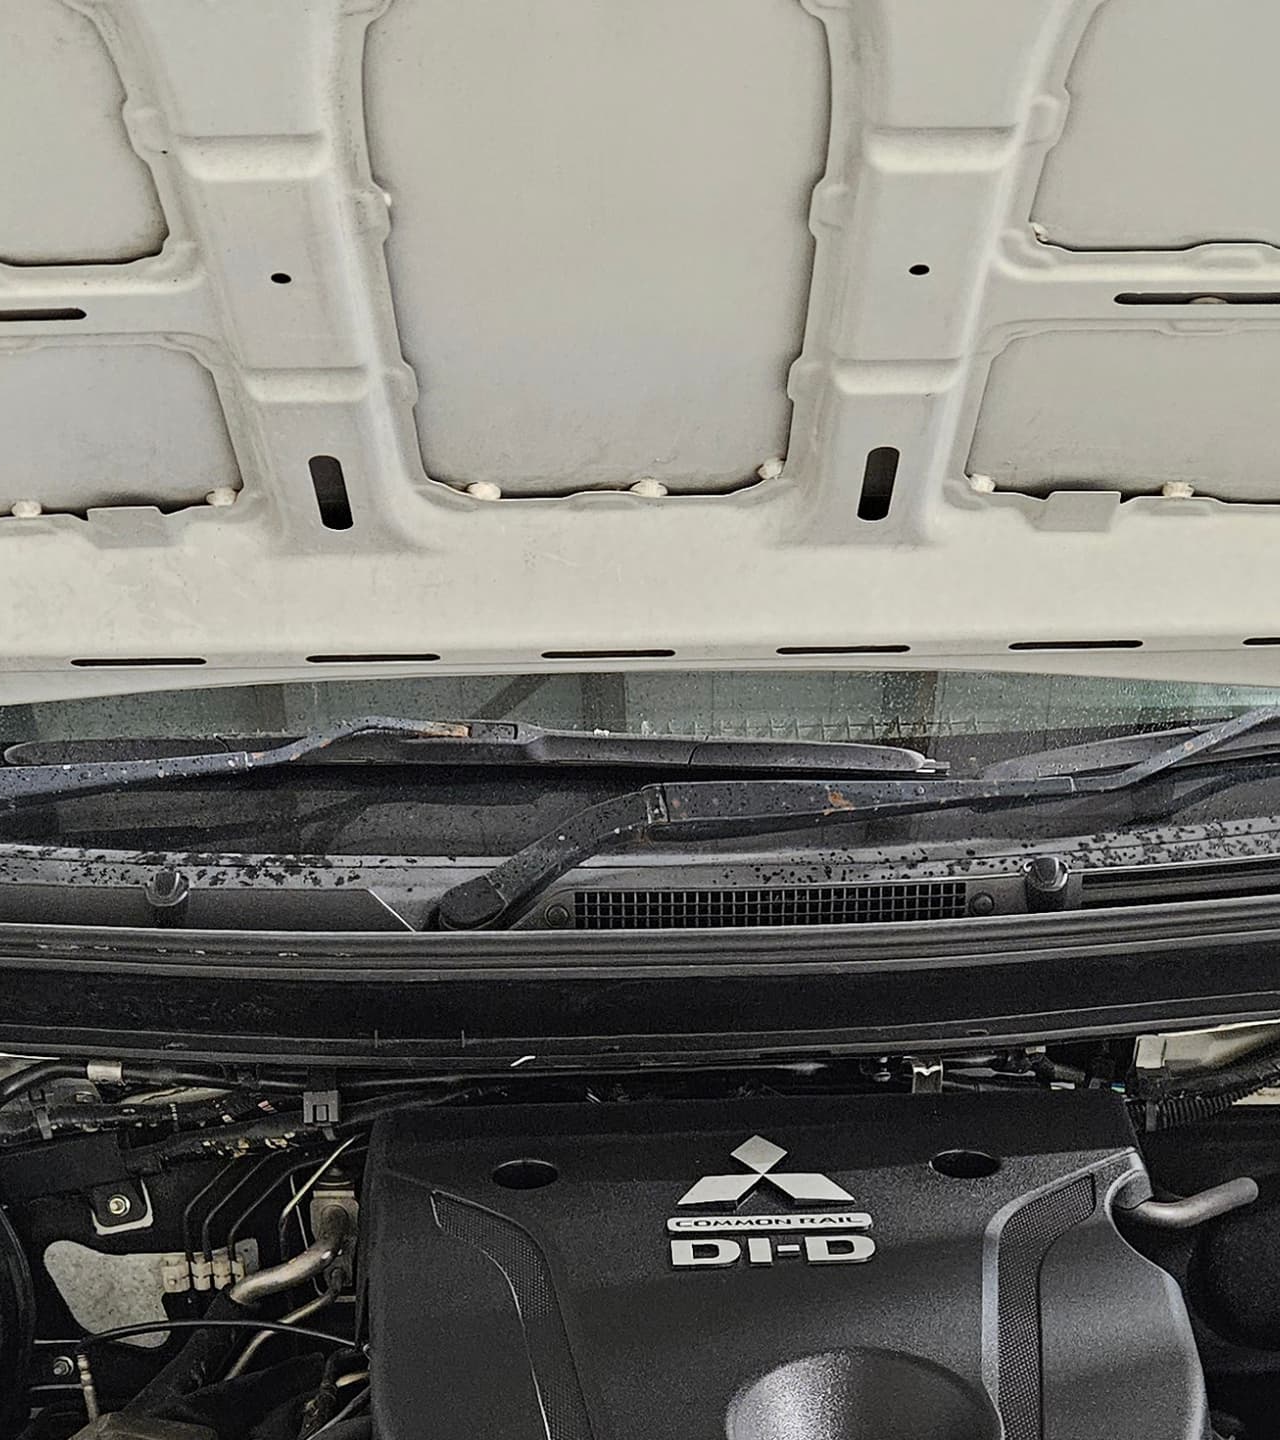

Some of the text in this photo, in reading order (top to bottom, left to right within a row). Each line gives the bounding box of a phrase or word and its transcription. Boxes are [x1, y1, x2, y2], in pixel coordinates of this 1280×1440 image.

[675, 1216, 864, 1227] COMMON RAIL
[670, 1235, 876, 1266] DI-D
